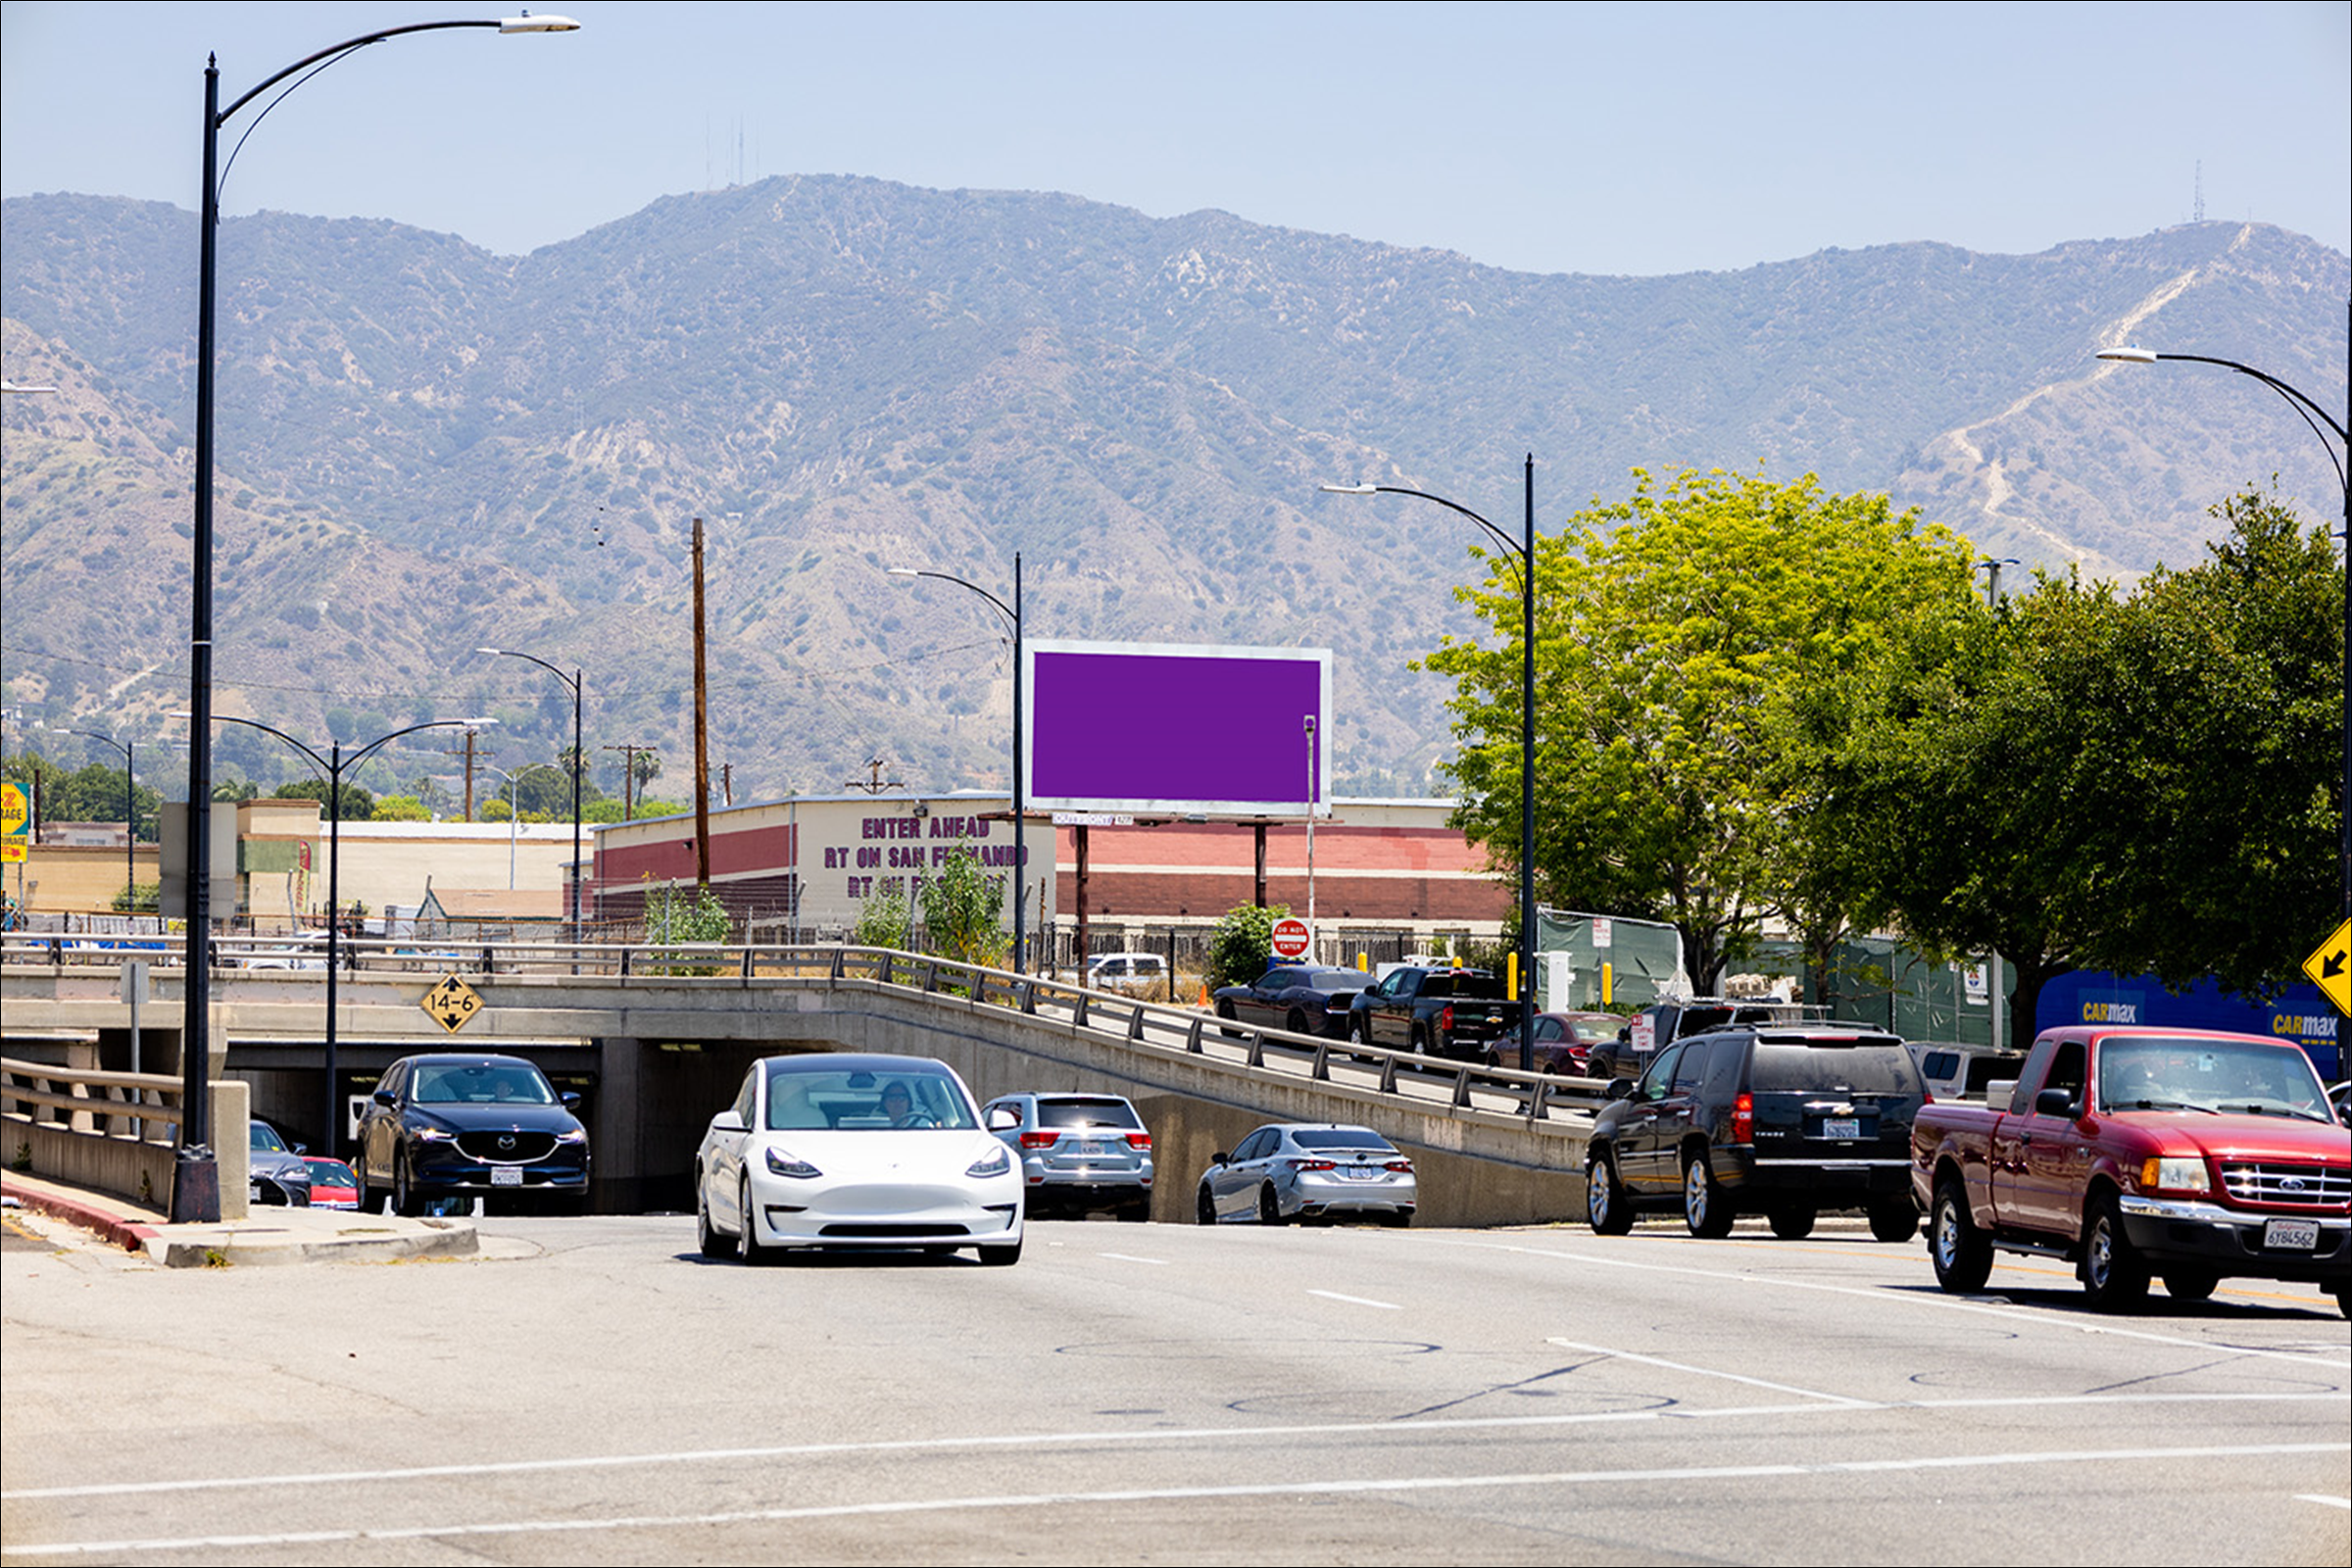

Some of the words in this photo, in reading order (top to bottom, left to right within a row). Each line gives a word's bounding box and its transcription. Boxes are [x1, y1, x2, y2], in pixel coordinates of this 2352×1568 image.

[861, 817, 921, 839] ENTER
[929, 816, 990, 838] AHEAD
[824, 847, 849, 868] RT
[857, 847, 881, 868] ON
[888, 847, 925, 868] SAN
[848, 876, 872, 898] RT
[2082, 1002, 2136, 1024] CARmax
[2273, 1014, 2338, 1037] CARmax
